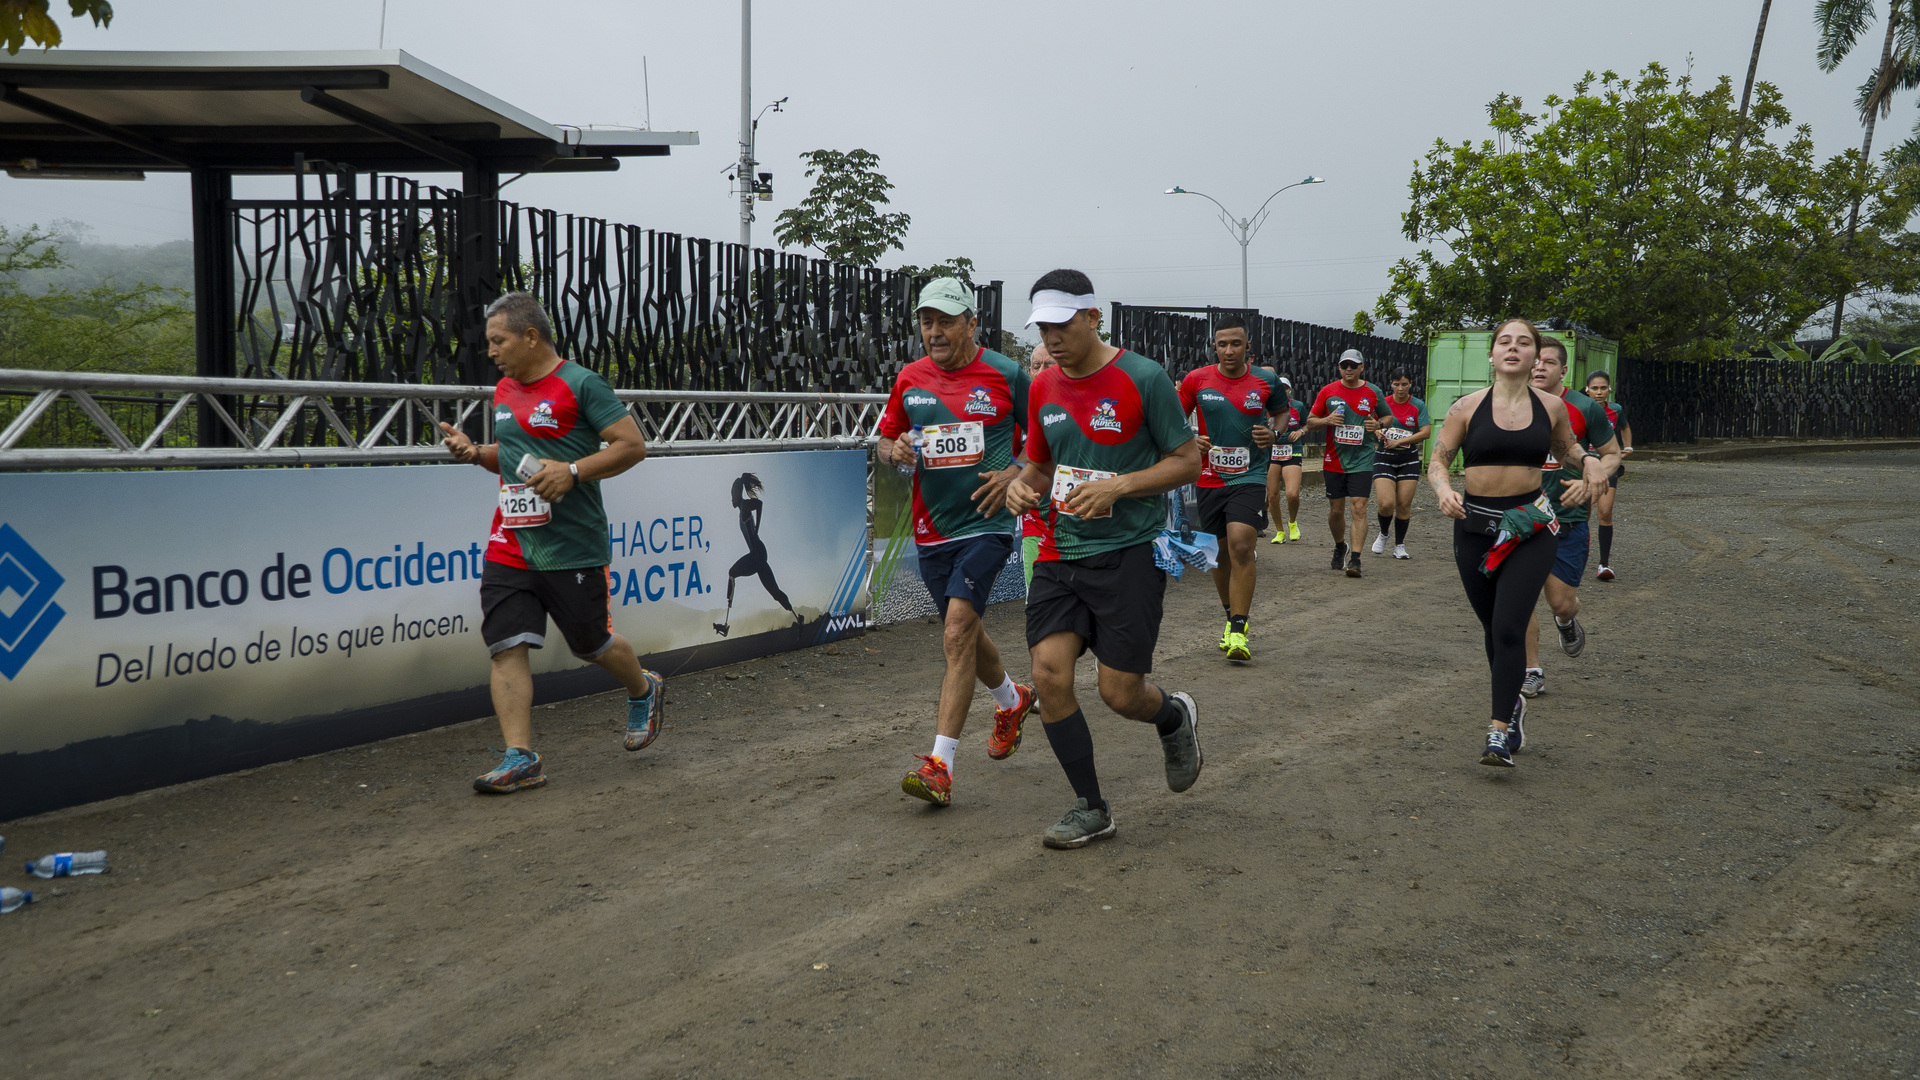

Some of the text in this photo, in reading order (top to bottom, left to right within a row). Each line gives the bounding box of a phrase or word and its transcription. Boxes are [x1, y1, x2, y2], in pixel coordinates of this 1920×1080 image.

[944, 293, 961, 302] 2XU
[1340, 430, 1359, 439] 1150
[935, 436, 967, 454] 508
[1272, 448, 1288, 456] 1231
[1214, 454, 1243, 466] 1386
[504, 497, 537, 513] 1261
[609, 515, 711, 558] HACER,
[92, 541, 487, 620] Banco de Occident
[826, 614, 864, 633] AVAL
[95, 613, 469, 688] Del lado de los que hacen.
